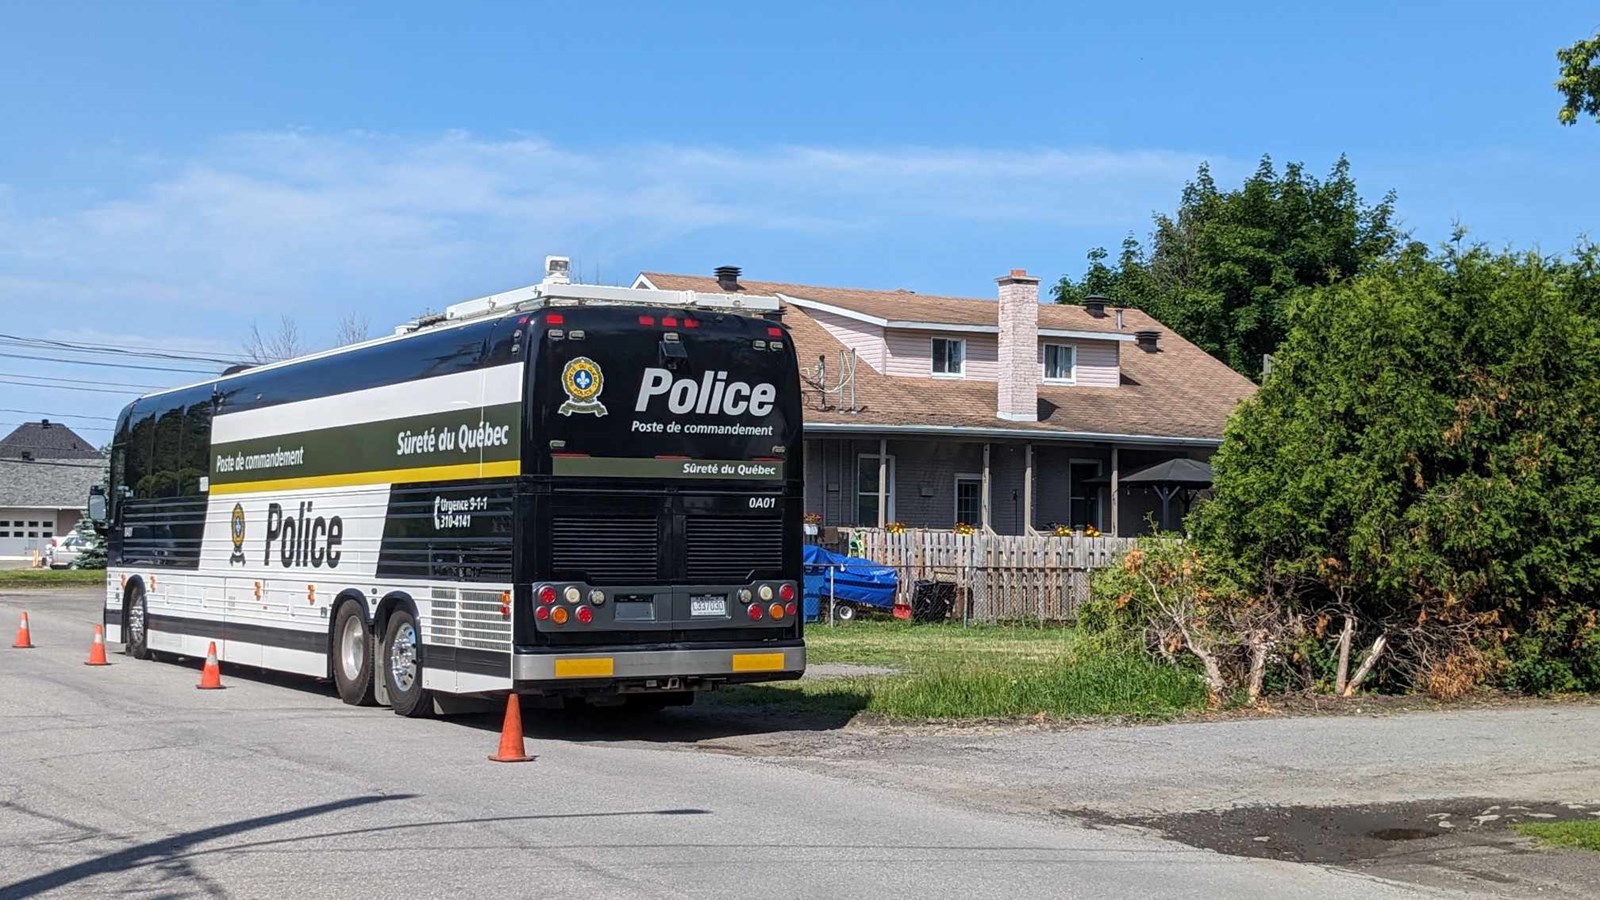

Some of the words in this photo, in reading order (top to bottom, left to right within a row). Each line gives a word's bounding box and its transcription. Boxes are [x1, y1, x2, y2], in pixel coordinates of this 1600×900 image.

[635, 367, 776, 416] Police
[397, 427, 435, 455] Sûreté
[438, 426, 455, 452] du
[458, 421, 509, 453] Québec
[631, 420, 664, 433] Poste
[666, 421, 681, 433] de
[684, 423, 773, 436] commandement
[216, 454, 234, 473] Poste
[235, 451, 244, 471] de
[245, 446, 304, 470] commandement
[682, 463, 719, 474] Sûreté
[720, 464, 735, 474] du
[737, 464, 776, 475] Québec
[440, 499, 469, 514] Urgence
[469, 496, 488, 510] 9-1-1
[440, 514, 471, 528] 310-4141
[264, 501, 343, 569] Police
